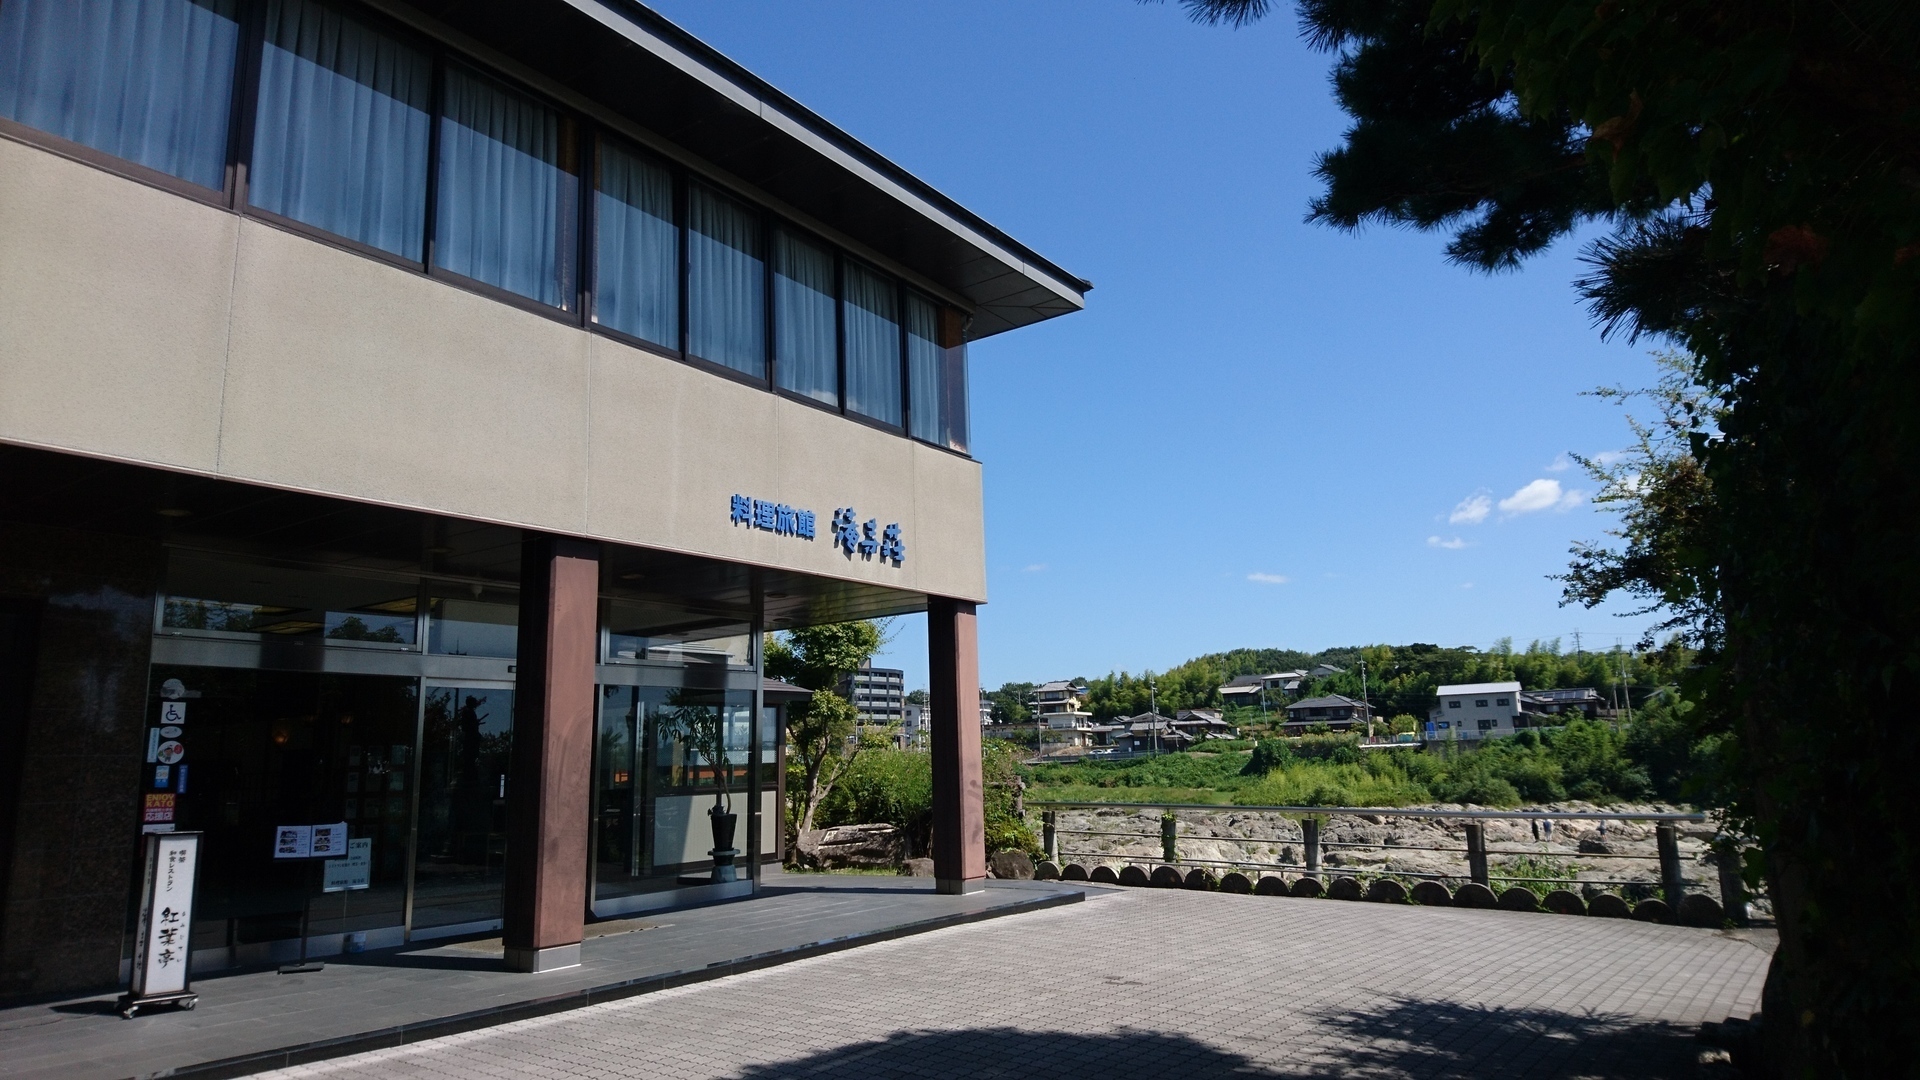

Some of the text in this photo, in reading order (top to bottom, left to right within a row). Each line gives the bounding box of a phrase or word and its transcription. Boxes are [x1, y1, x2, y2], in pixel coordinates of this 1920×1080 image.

[730, 494, 816, 540] 料理旅館
[146, 793, 174, 801] ENJOY
[146, 800, 174, 808] KATO
[178, 849, 187, 864] 喫茶
[166, 850, 177, 892] 和食レストラン
[158, 906, 180, 969] 紅葉亭
